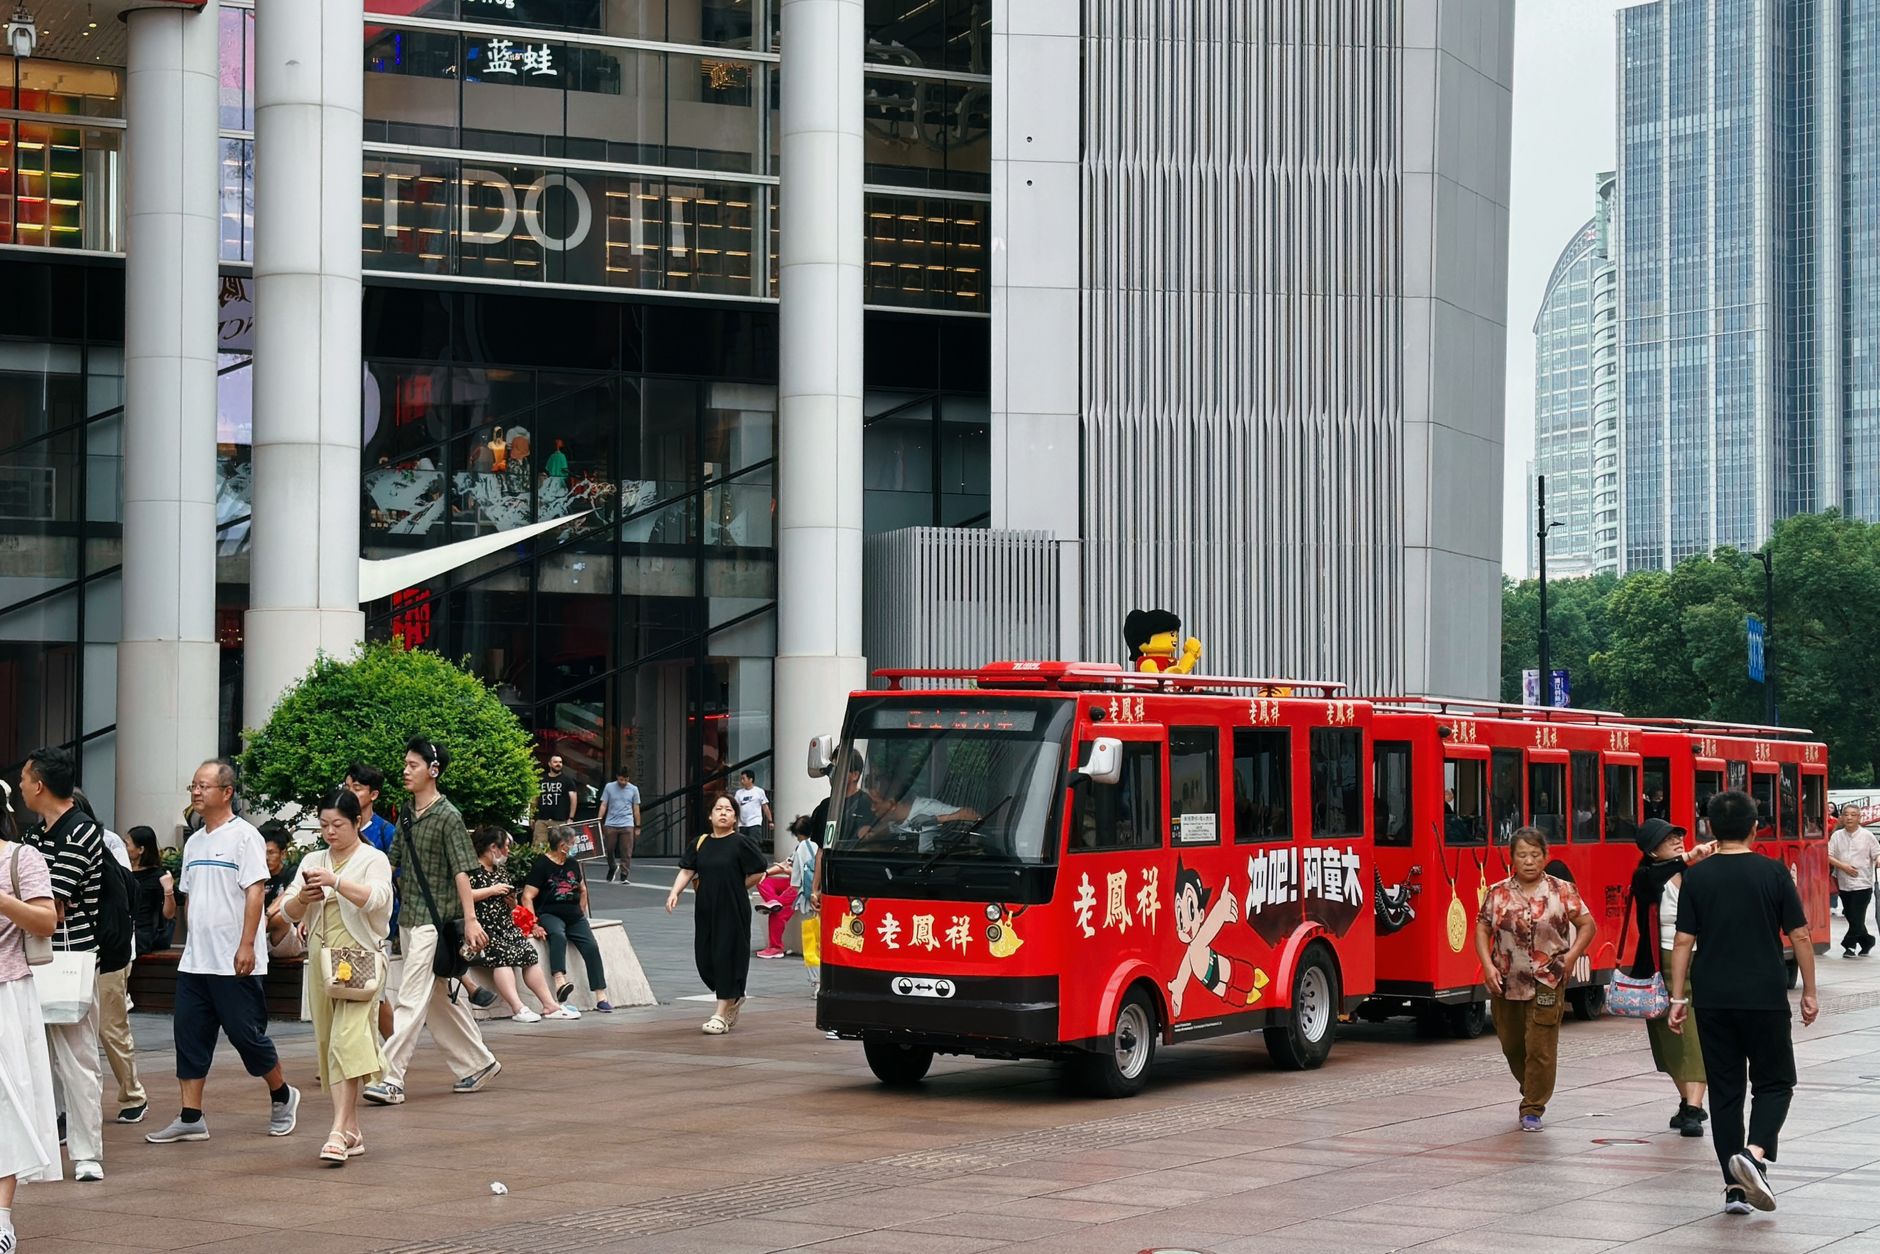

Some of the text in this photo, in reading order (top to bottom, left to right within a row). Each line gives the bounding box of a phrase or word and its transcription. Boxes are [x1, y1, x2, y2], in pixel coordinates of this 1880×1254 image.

[482, 39, 558, 76] 蓝蛙
[460, 167, 592, 251] DO
[630, 182, 705, 258] IT
[1109, 697, 1145, 725] 老鳳祥
[1249, 700, 1280, 726] 老鳳祥
[1327, 702, 1356, 726] 老鳳祥
[1073, 865, 1163, 939] 老鳳祥
[877, 912, 974, 957] 老鳳祥
